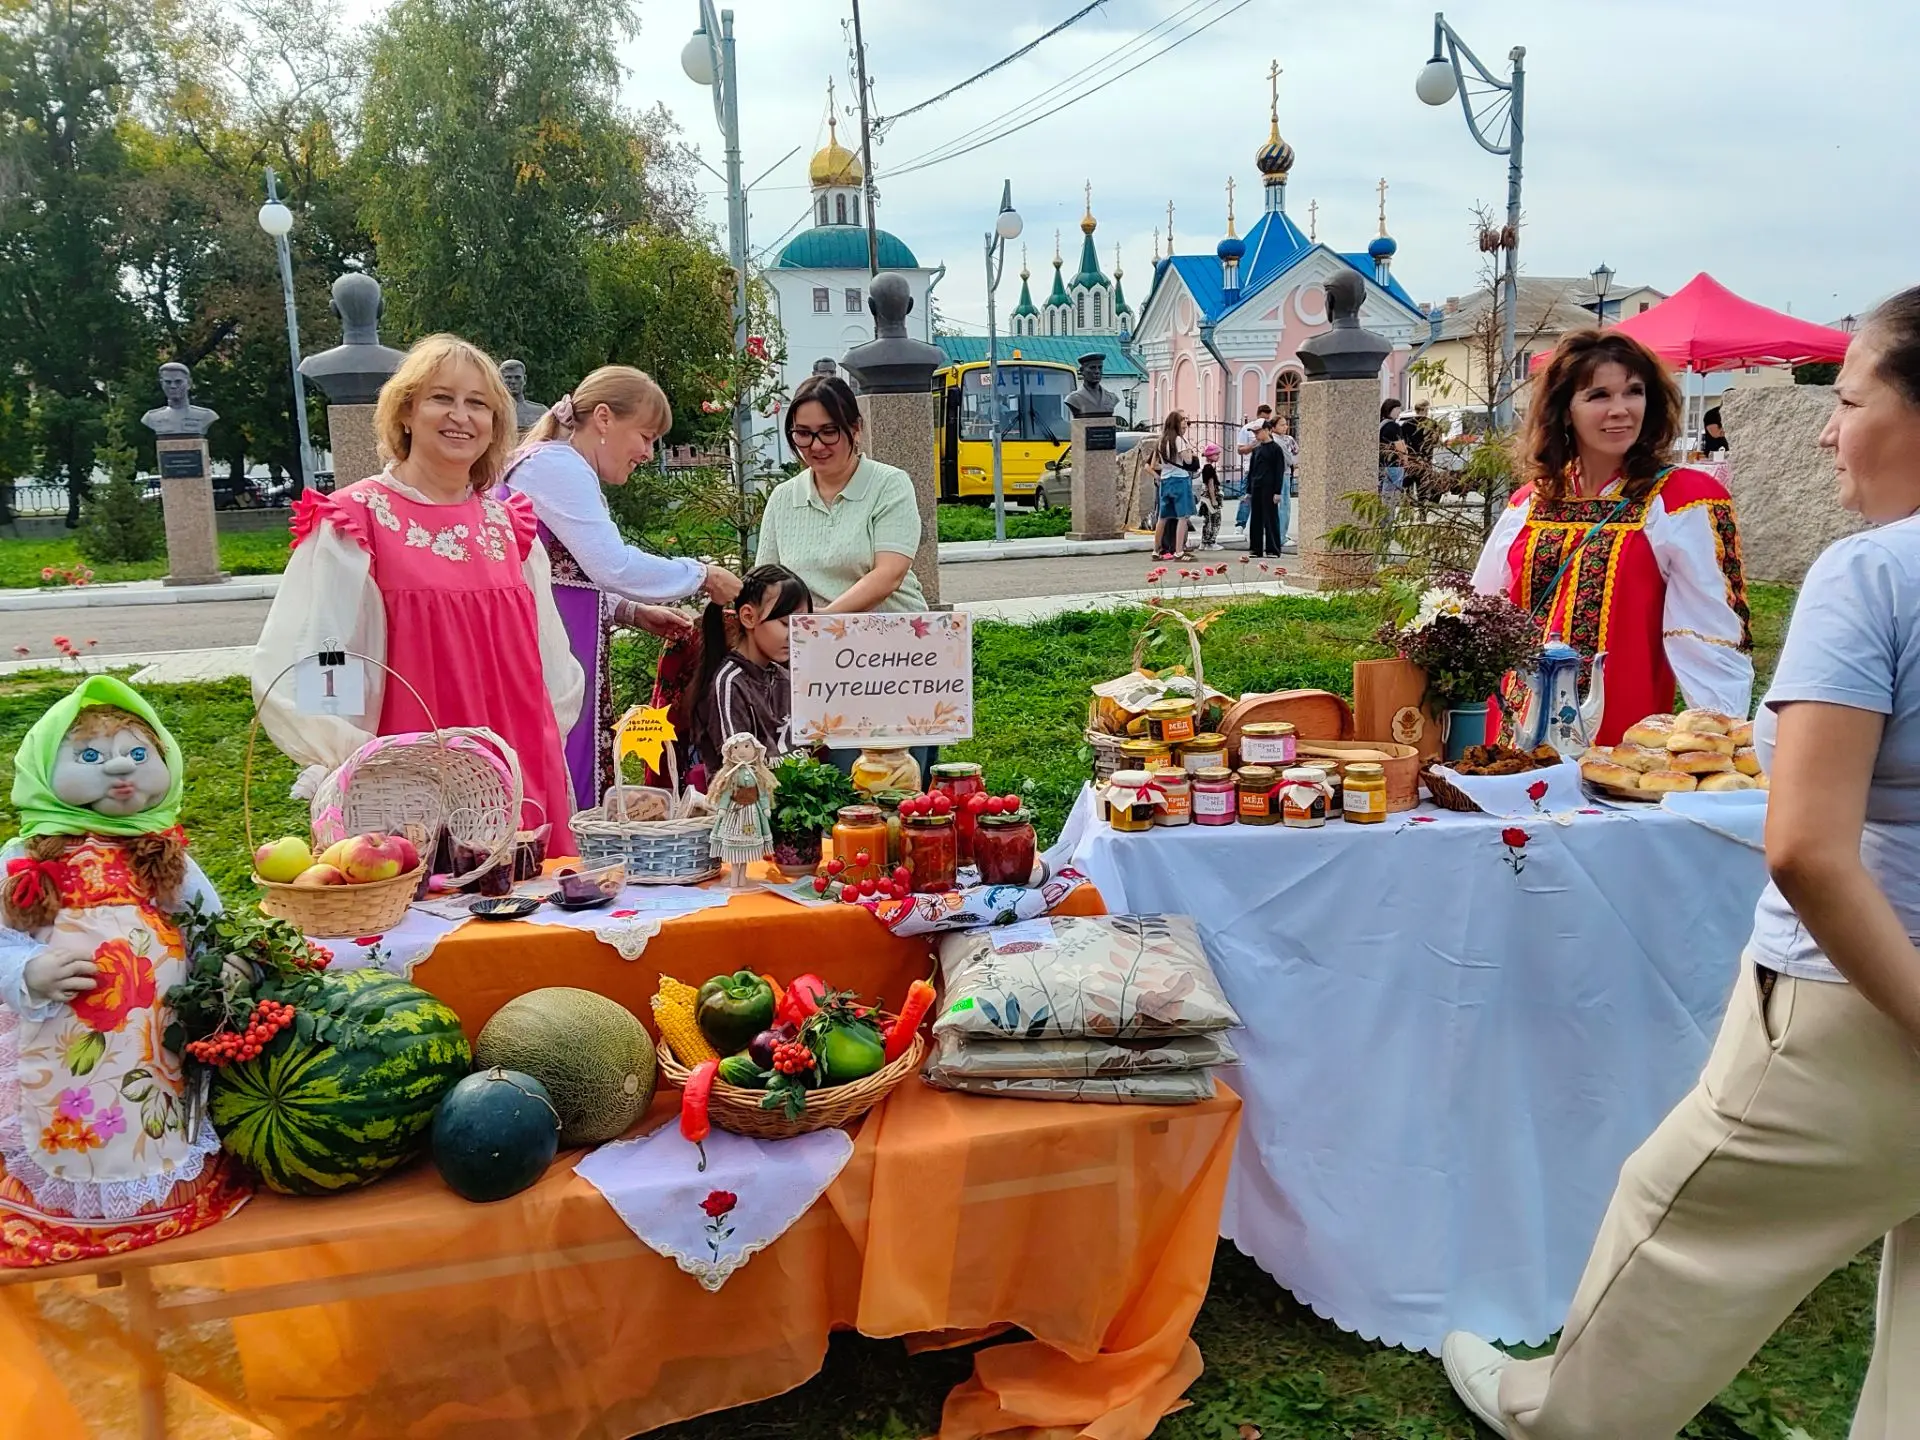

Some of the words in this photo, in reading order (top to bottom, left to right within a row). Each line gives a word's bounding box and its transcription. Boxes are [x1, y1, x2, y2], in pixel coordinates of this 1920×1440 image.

[997, 370, 1045, 387] ДЕТИ
[835, 648, 938, 669] Осеннее
[321, 669, 338, 698] 1
[807, 678, 965, 703] путешествие
[1243, 795, 1264, 804] МЁД
